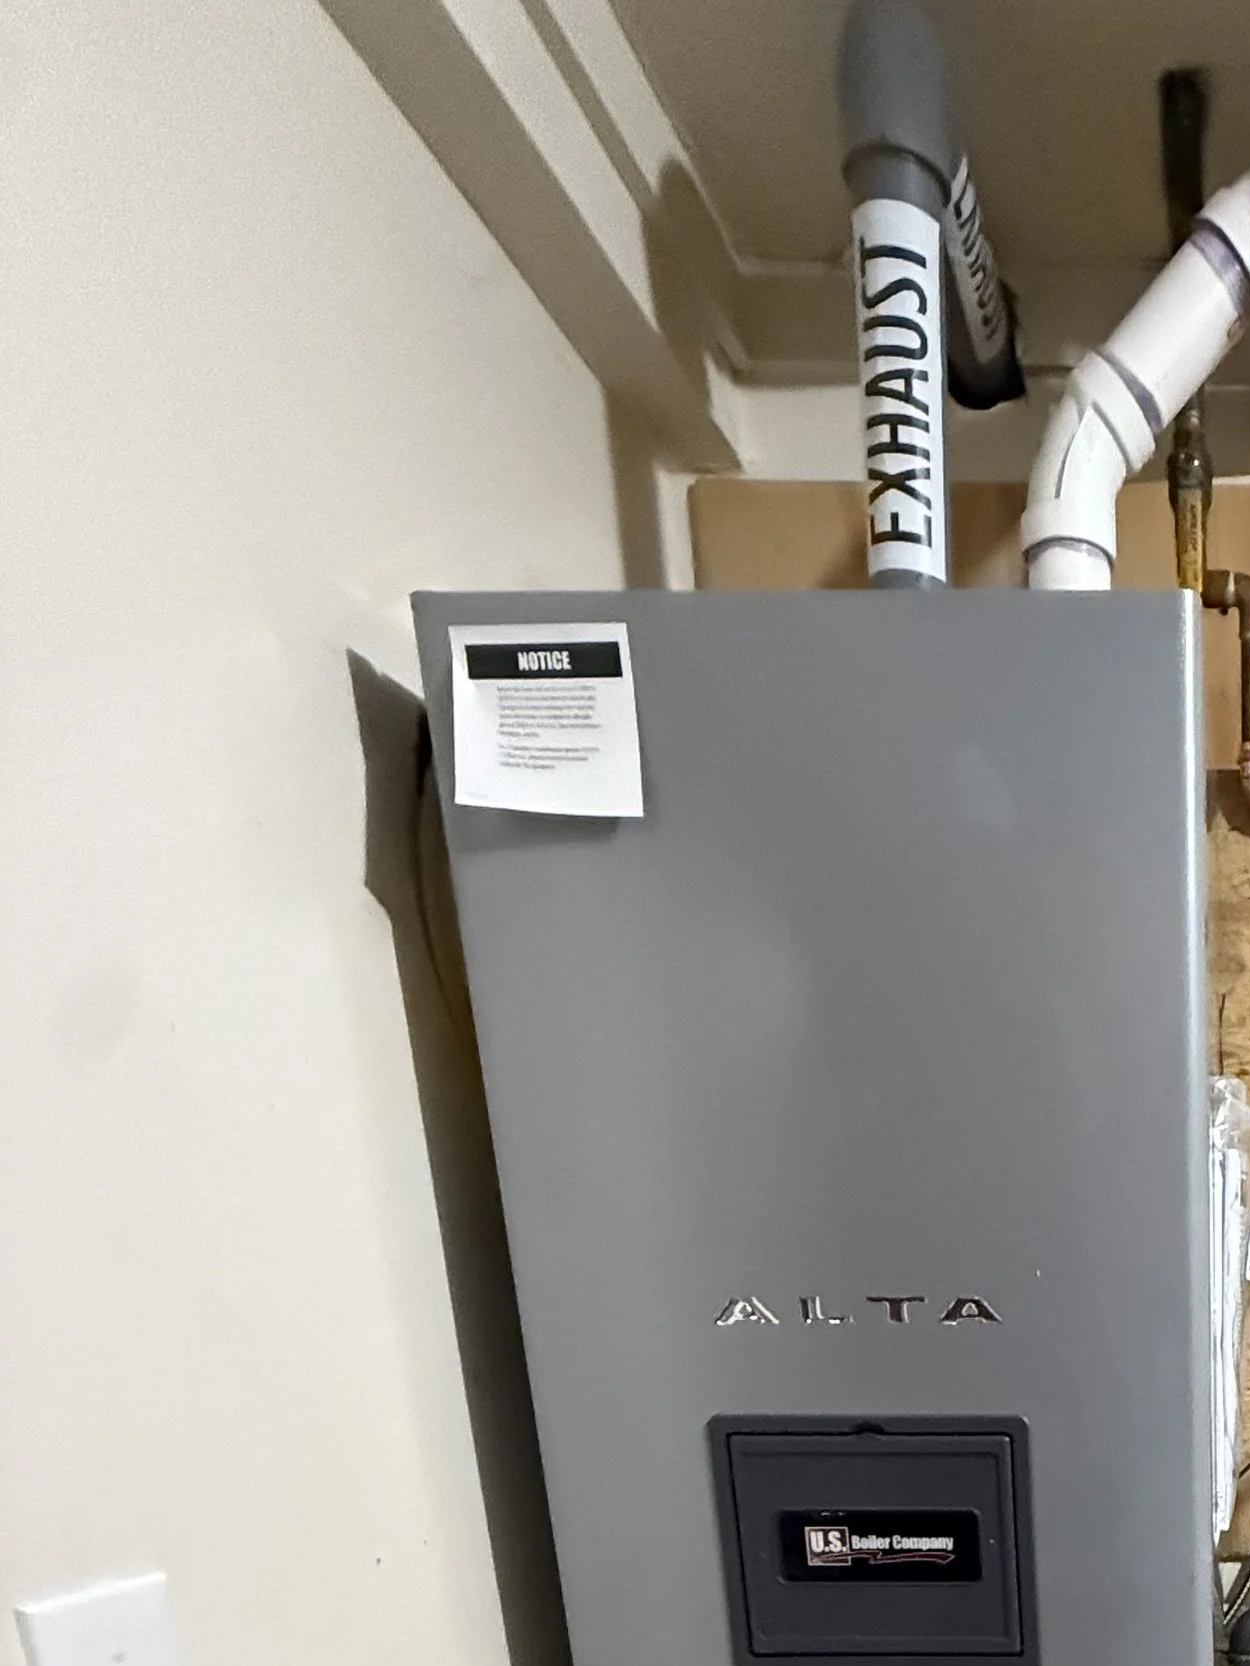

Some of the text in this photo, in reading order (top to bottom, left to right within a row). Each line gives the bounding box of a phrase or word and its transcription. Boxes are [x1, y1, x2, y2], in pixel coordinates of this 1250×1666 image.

[860, 237, 933, 548] EXHAUST
[517, 650, 572, 672] NOTICE
[714, 1296, 1002, 1325] ALTA
[809, 1530, 954, 1553] U.S. Boiler Company
